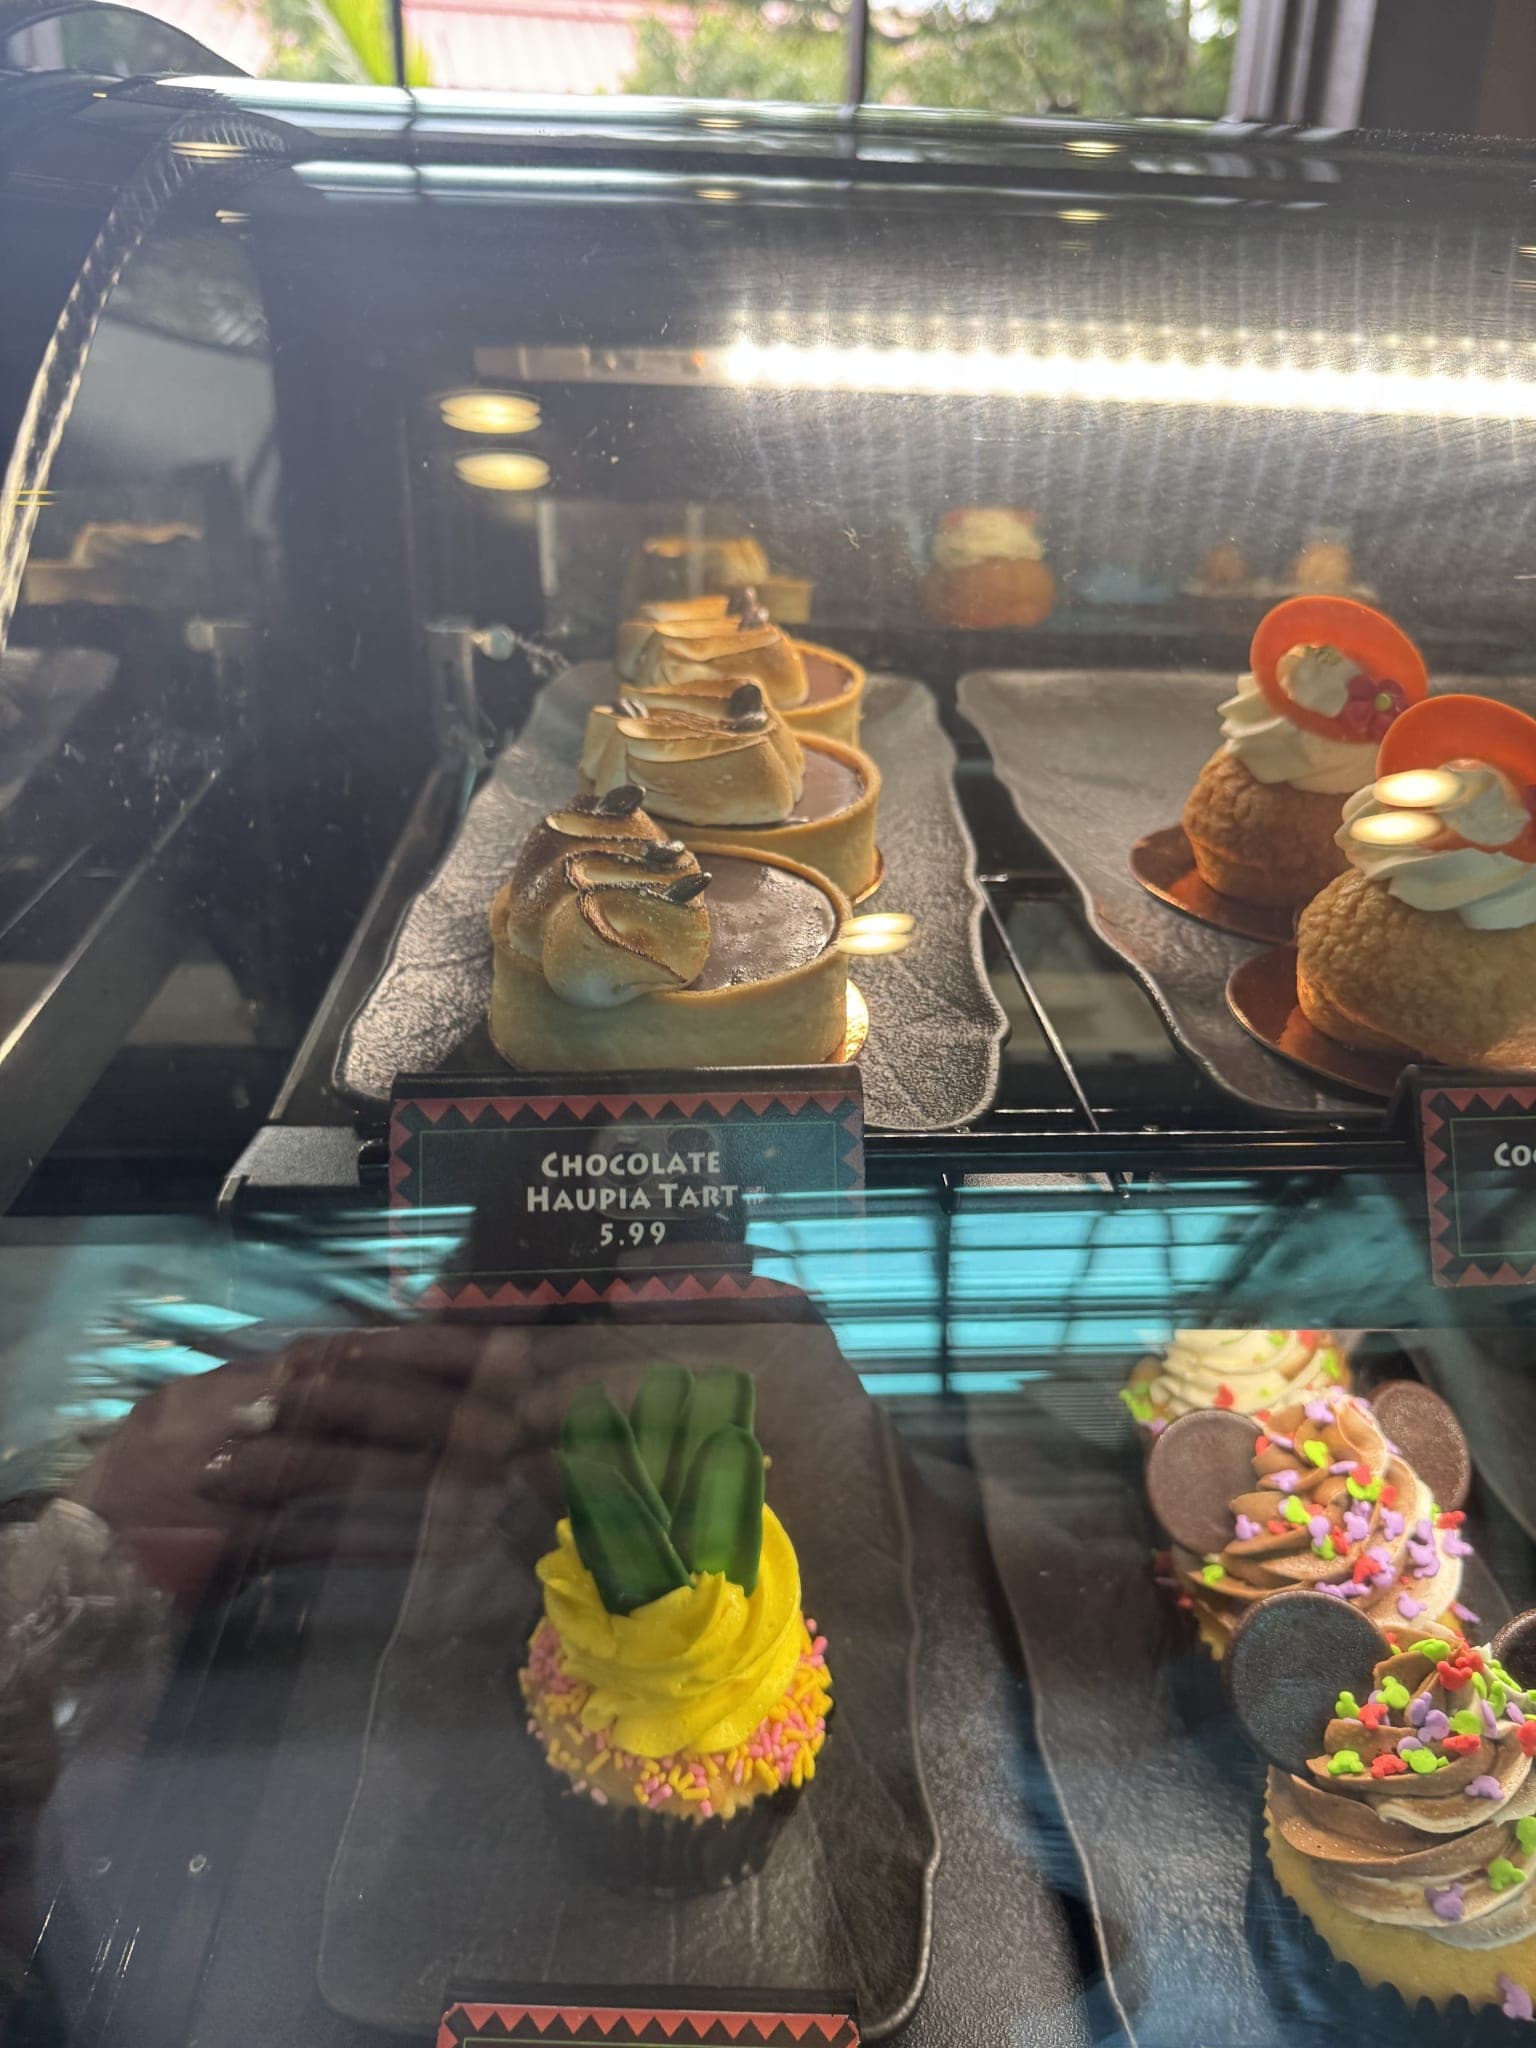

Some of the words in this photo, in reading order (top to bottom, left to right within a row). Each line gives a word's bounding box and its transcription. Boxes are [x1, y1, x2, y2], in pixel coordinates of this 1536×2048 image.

[541, 1151, 721, 1178] CHOCOLATE
[1494, 1142, 1536, 1167] CO
[526, 1185, 652, 1213] HAUPIA
[658, 1182, 739, 1209] TART
[600, 1221, 667, 1247] 5.99
